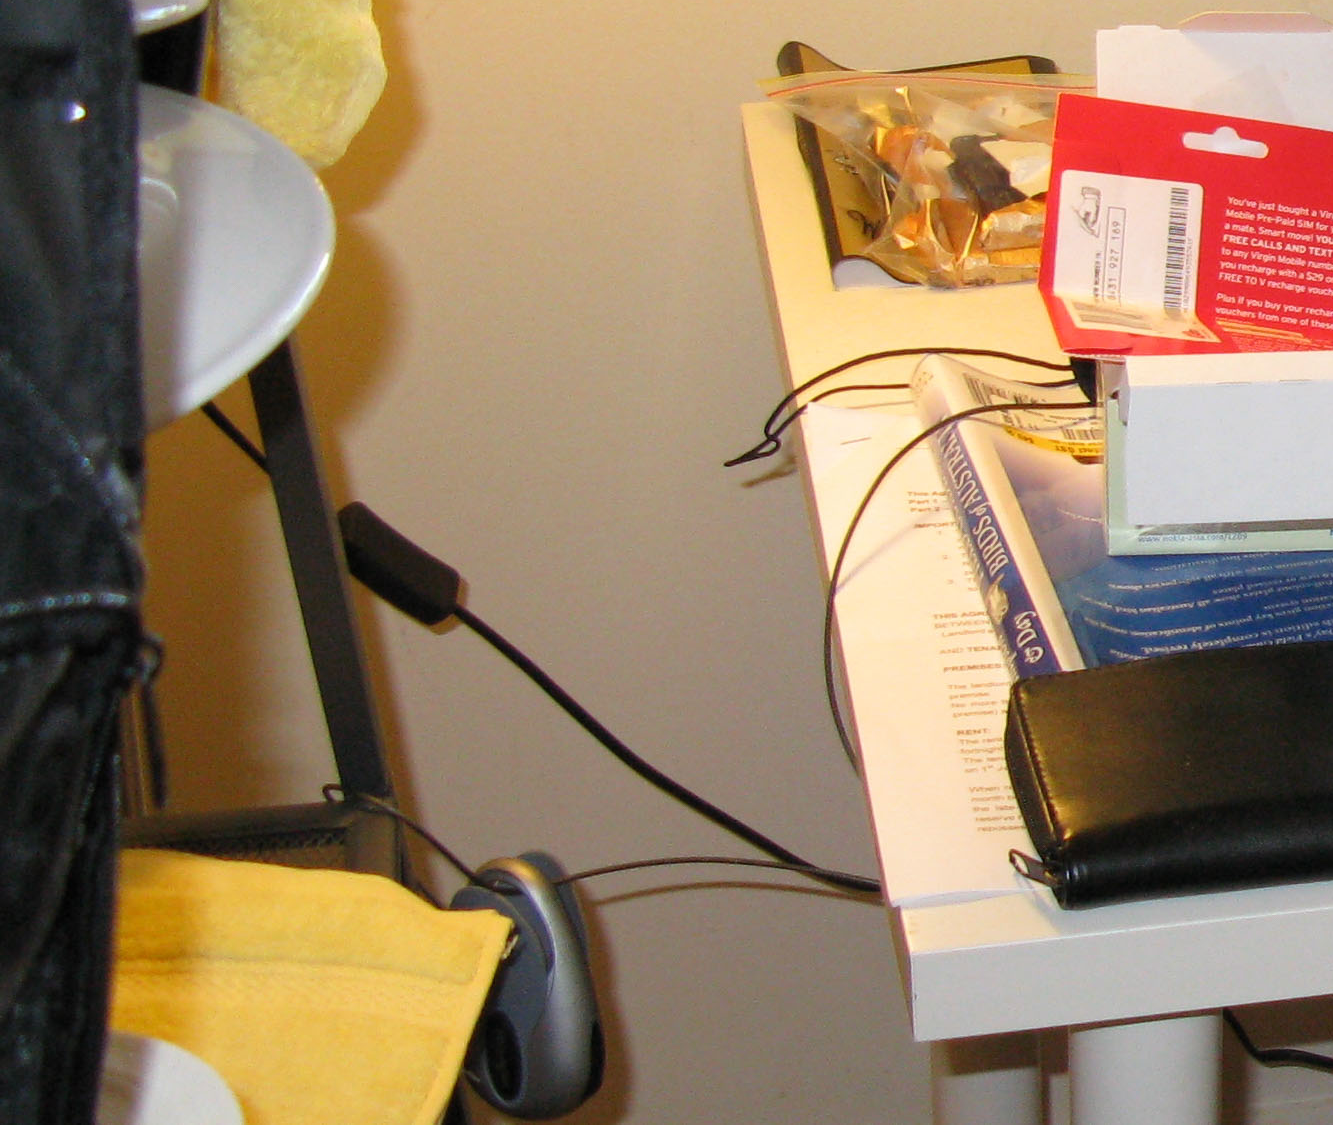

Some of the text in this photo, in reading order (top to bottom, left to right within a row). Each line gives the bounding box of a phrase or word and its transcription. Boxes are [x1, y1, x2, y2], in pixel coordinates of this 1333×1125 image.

[1228, 196, 1257, 208] You've
[1258, 199, 1275, 212] just
[1278, 203, 1309, 216] bought
[1312, 209, 1317, 217] a
[1225, 209, 1255, 220] Mobile
[1256, 213, 1295, 226] Pre-Paid
[1297, 219, 1314, 229] SIM
[1315, 222, 1328, 231] for
[1232, 224, 1256, 234] mate.
[1259, 226, 1286, 237] Smart
[1223, 234, 1249, 245] FREE
[1250, 238, 1283, 250] CALLS
[1284, 243, 1307, 254] AND
[1308, 246, 1333, 258] TEXT
[1109, 249, 1120, 270] 927
[1221, 247, 1231, 256] to
[1232, 249, 1249, 259] any
[1251, 251, 1276, 262] Virgin
[1278, 255, 1307, 267] Mobile
[1220, 261, 1236, 270] you
[1238, 262, 1277, 275] recharge
[1278, 267, 1297, 277] with
[1306, 271, 1324, 282] $29
[1218, 272, 1243, 284] FREE
[1244, 275, 1257, 285] TO
[1259, 278, 1267, 286] V
[1267, 278, 1306, 293] recharge
[1216, 293, 1236, 304] Plus
[1238, 296, 1245, 304] if
[1246, 297, 1263, 307] you
[1264, 299, 1281, 311] buy
[1283, 302, 1303, 312] your
[1215, 307, 1256, 319] vouchers
[1258, 311, 1280, 322] from
[1281, 314, 1297, 324] one
[1300, 316, 1309, 326] of
[973, 515, 1009, 577] BIRDS
[1139, 601, 1194, 613] Australian
[1014, 611, 1037, 648] Day
